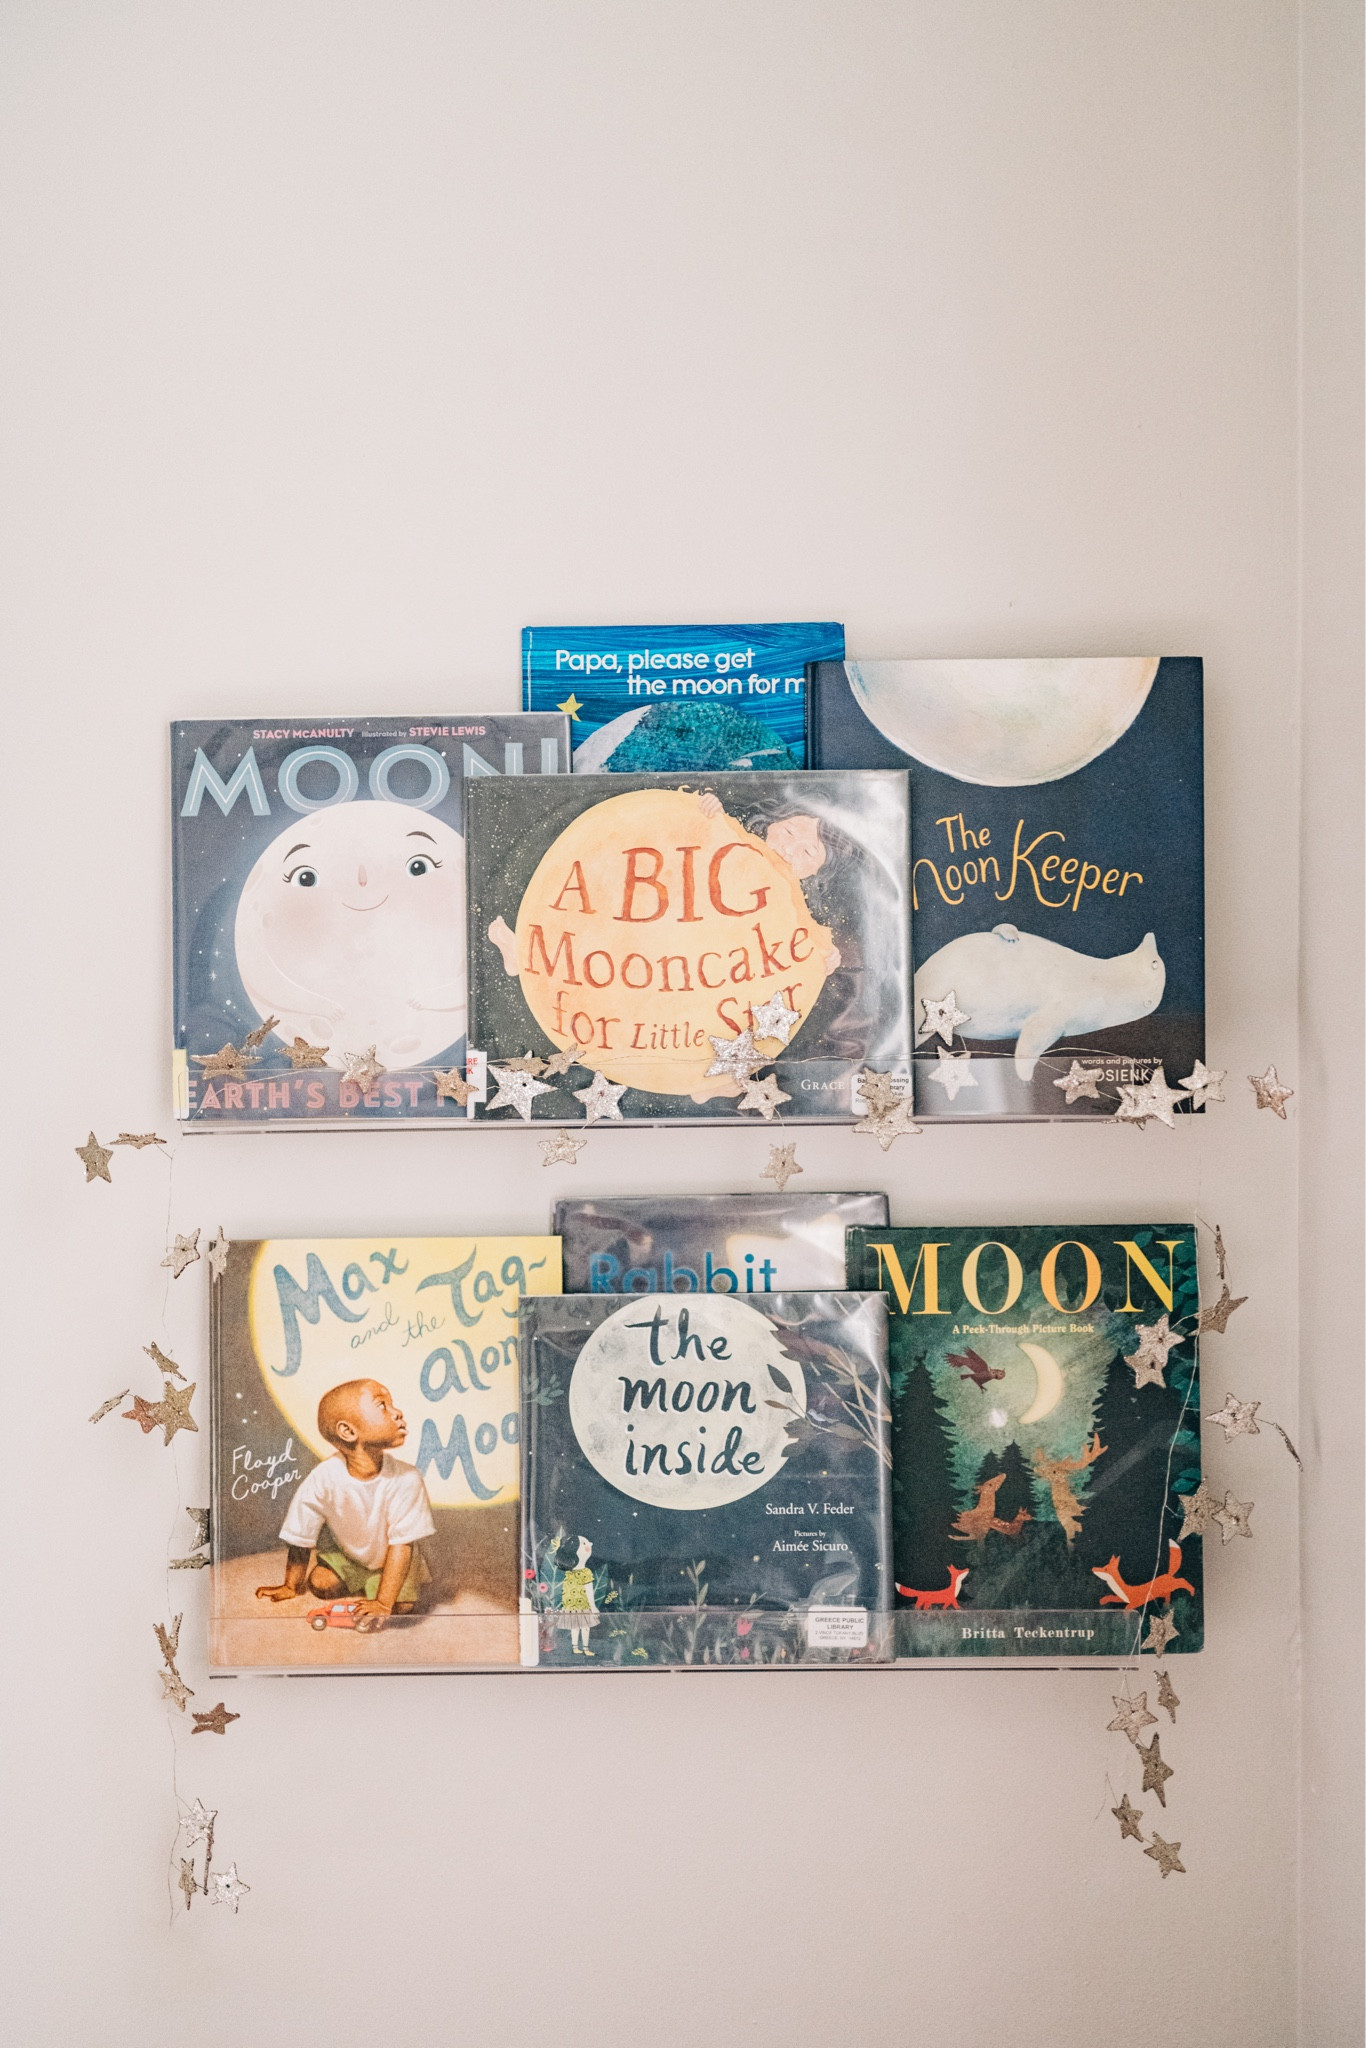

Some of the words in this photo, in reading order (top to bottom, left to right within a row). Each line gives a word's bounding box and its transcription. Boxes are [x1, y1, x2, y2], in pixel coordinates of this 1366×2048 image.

[555, 649, 623, 675] Papa,
[628, 649, 710, 674] please
[714, 647, 756, 674] get
[627, 674, 667, 695] the
[672, 677, 743, 695] moon
[748, 673, 779, 694] for
[785, 677, 805, 694] m
[253, 729, 290, 739] STACY
[361, 730, 398, 738] Illustrated
[398, 730, 407, 738] by
[409, 726, 449, 737] STEVIE
[451, 726, 487, 737] LEWIS
[935, 812, 992, 853] The
[547, 859, 597, 916] A
[612, 842, 772, 924] BIG
[995, 818, 1144, 912] Keeper
[523, 921, 815, 993] Mooncake
[551, 989, 624, 1050] for
[629, 1021, 706, 1050] Little
[716, 982, 803, 1036] Str
[1122, 1057, 1152, 1067] pictures
[1153, 1057, 1163, 1066] by
[340, 1081, 423, 1108] BEST
[801, 1079, 845, 1091] GRACE
[590, 1251, 777, 1293] Rabbit
[866, 1240, 1185, 1315] MOON
[271, 1247, 409, 1377] Max
[350, 1302, 400, 1349] and
[401, 1311, 446, 1348] the
[952, 1324, 960, 1334] A
[962, 1323, 1029, 1335] Peek-Through
[1032, 1323, 1067, 1333] Picture
[1069, 1323, 1095, 1333] Book
[624, 1304, 732, 1366] the
[618, 1375, 757, 1415] moon
[232, 1438, 297, 1478] Floyd
[415, 1412, 519, 1501] Moo
[625, 1424, 766, 1476] inside
[231, 1469, 302, 1500] Cooper
[765, 1502, 804, 1515] Sandra
[807, 1503, 820, 1515] V.
[823, 1502, 855, 1514] Feder
[773, 1540, 809, 1552] Aimée
[812, 1540, 849, 1552] Sicuro
[818, 1530, 827, 1538] by
[961, 1627, 1006, 1639] Britta
[1013, 1626, 1095, 1640] Teckentrup
